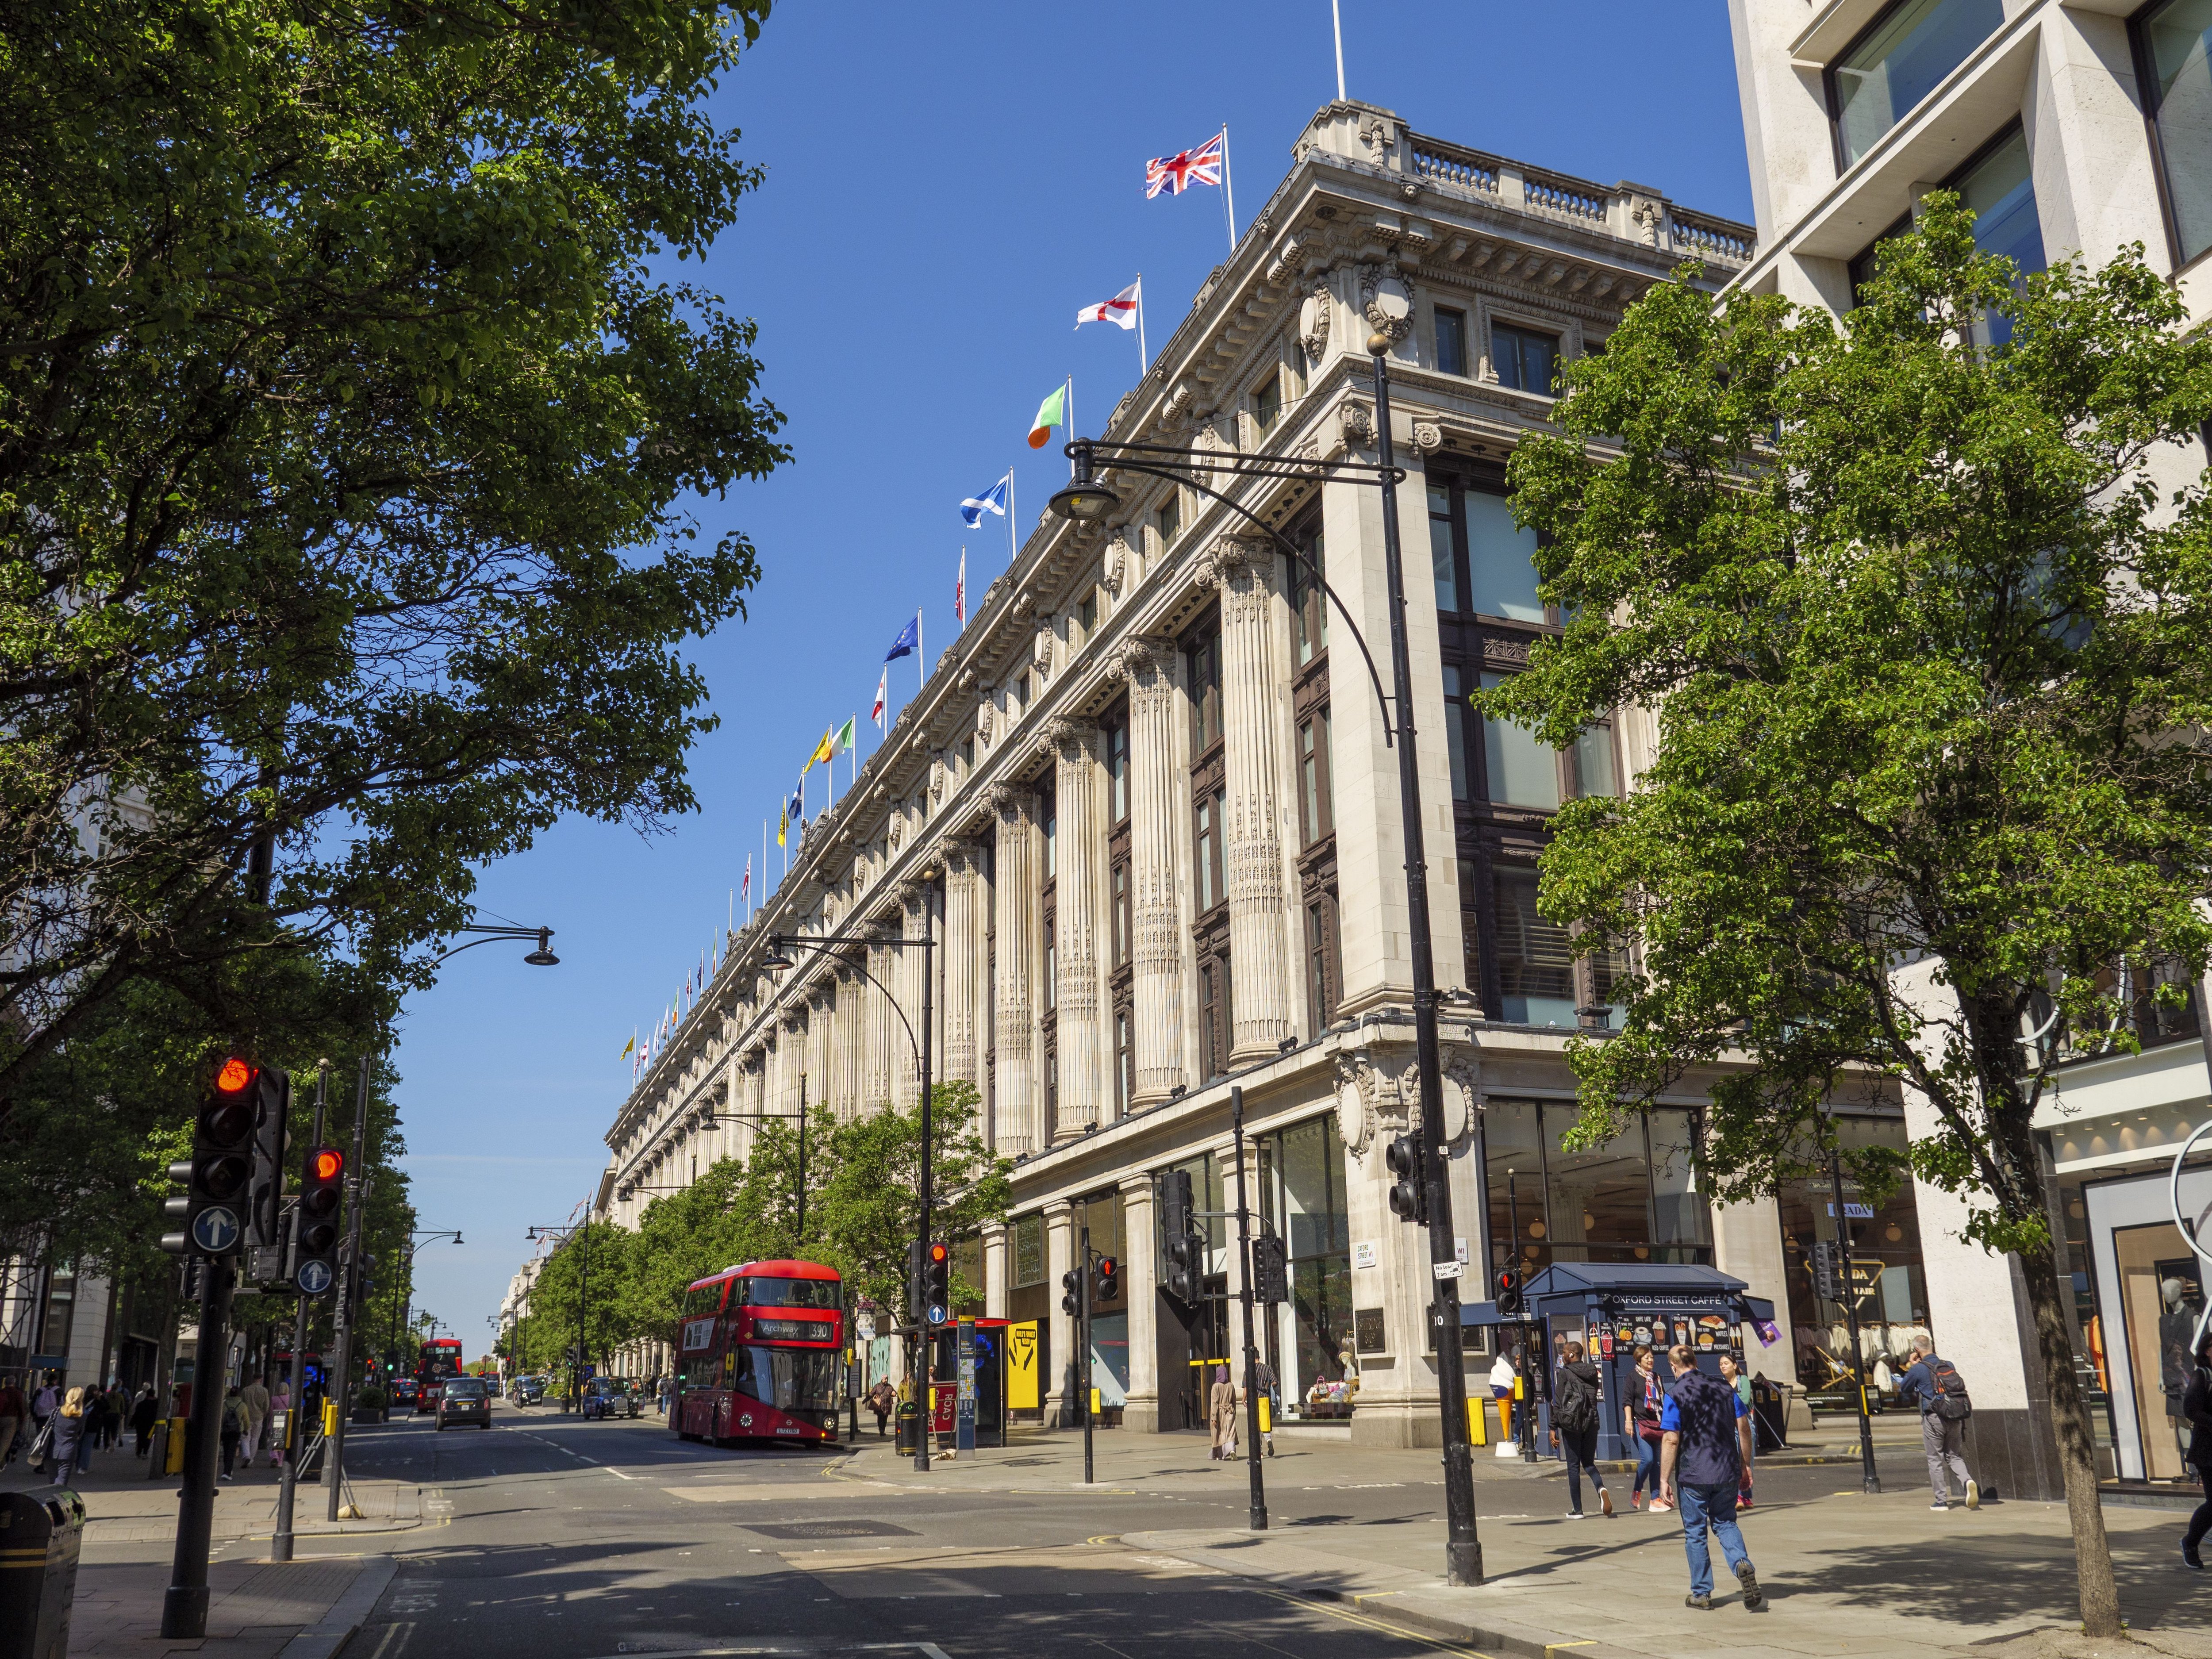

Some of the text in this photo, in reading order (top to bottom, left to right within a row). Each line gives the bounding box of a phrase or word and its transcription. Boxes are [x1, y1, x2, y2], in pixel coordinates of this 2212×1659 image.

[1859, 1287, 1876, 1295] AIR
[1613, 1295, 1652, 1304] OXFORD
[1654, 1295, 1689, 1305] STREET
[763, 1323, 827, 1337] Archway 390
[942, 1394, 953, 1420] ROAD
